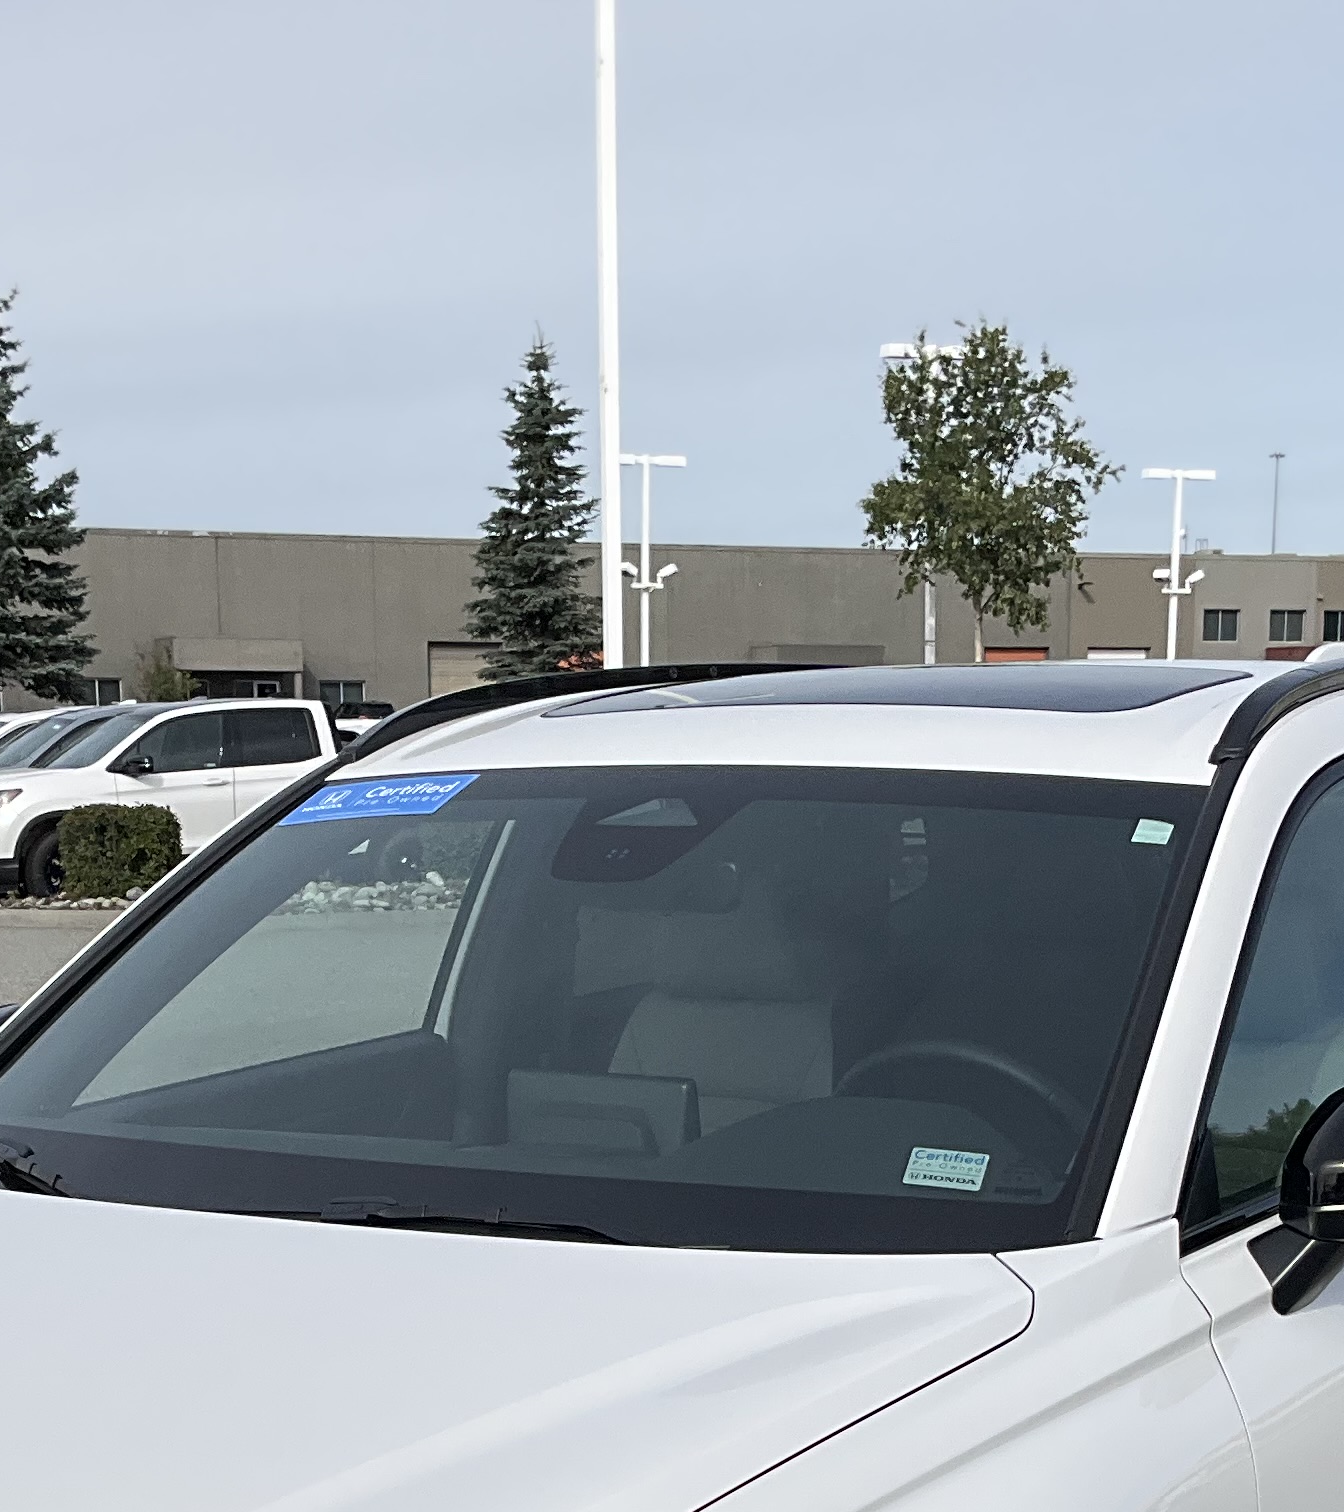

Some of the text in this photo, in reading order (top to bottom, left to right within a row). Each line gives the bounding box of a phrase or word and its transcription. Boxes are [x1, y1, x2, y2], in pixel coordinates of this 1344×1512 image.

[365, 780, 460, 799] Certified
[914, 1149, 986, 1166] Certified
[922, 1174, 977, 1186] HONDA
